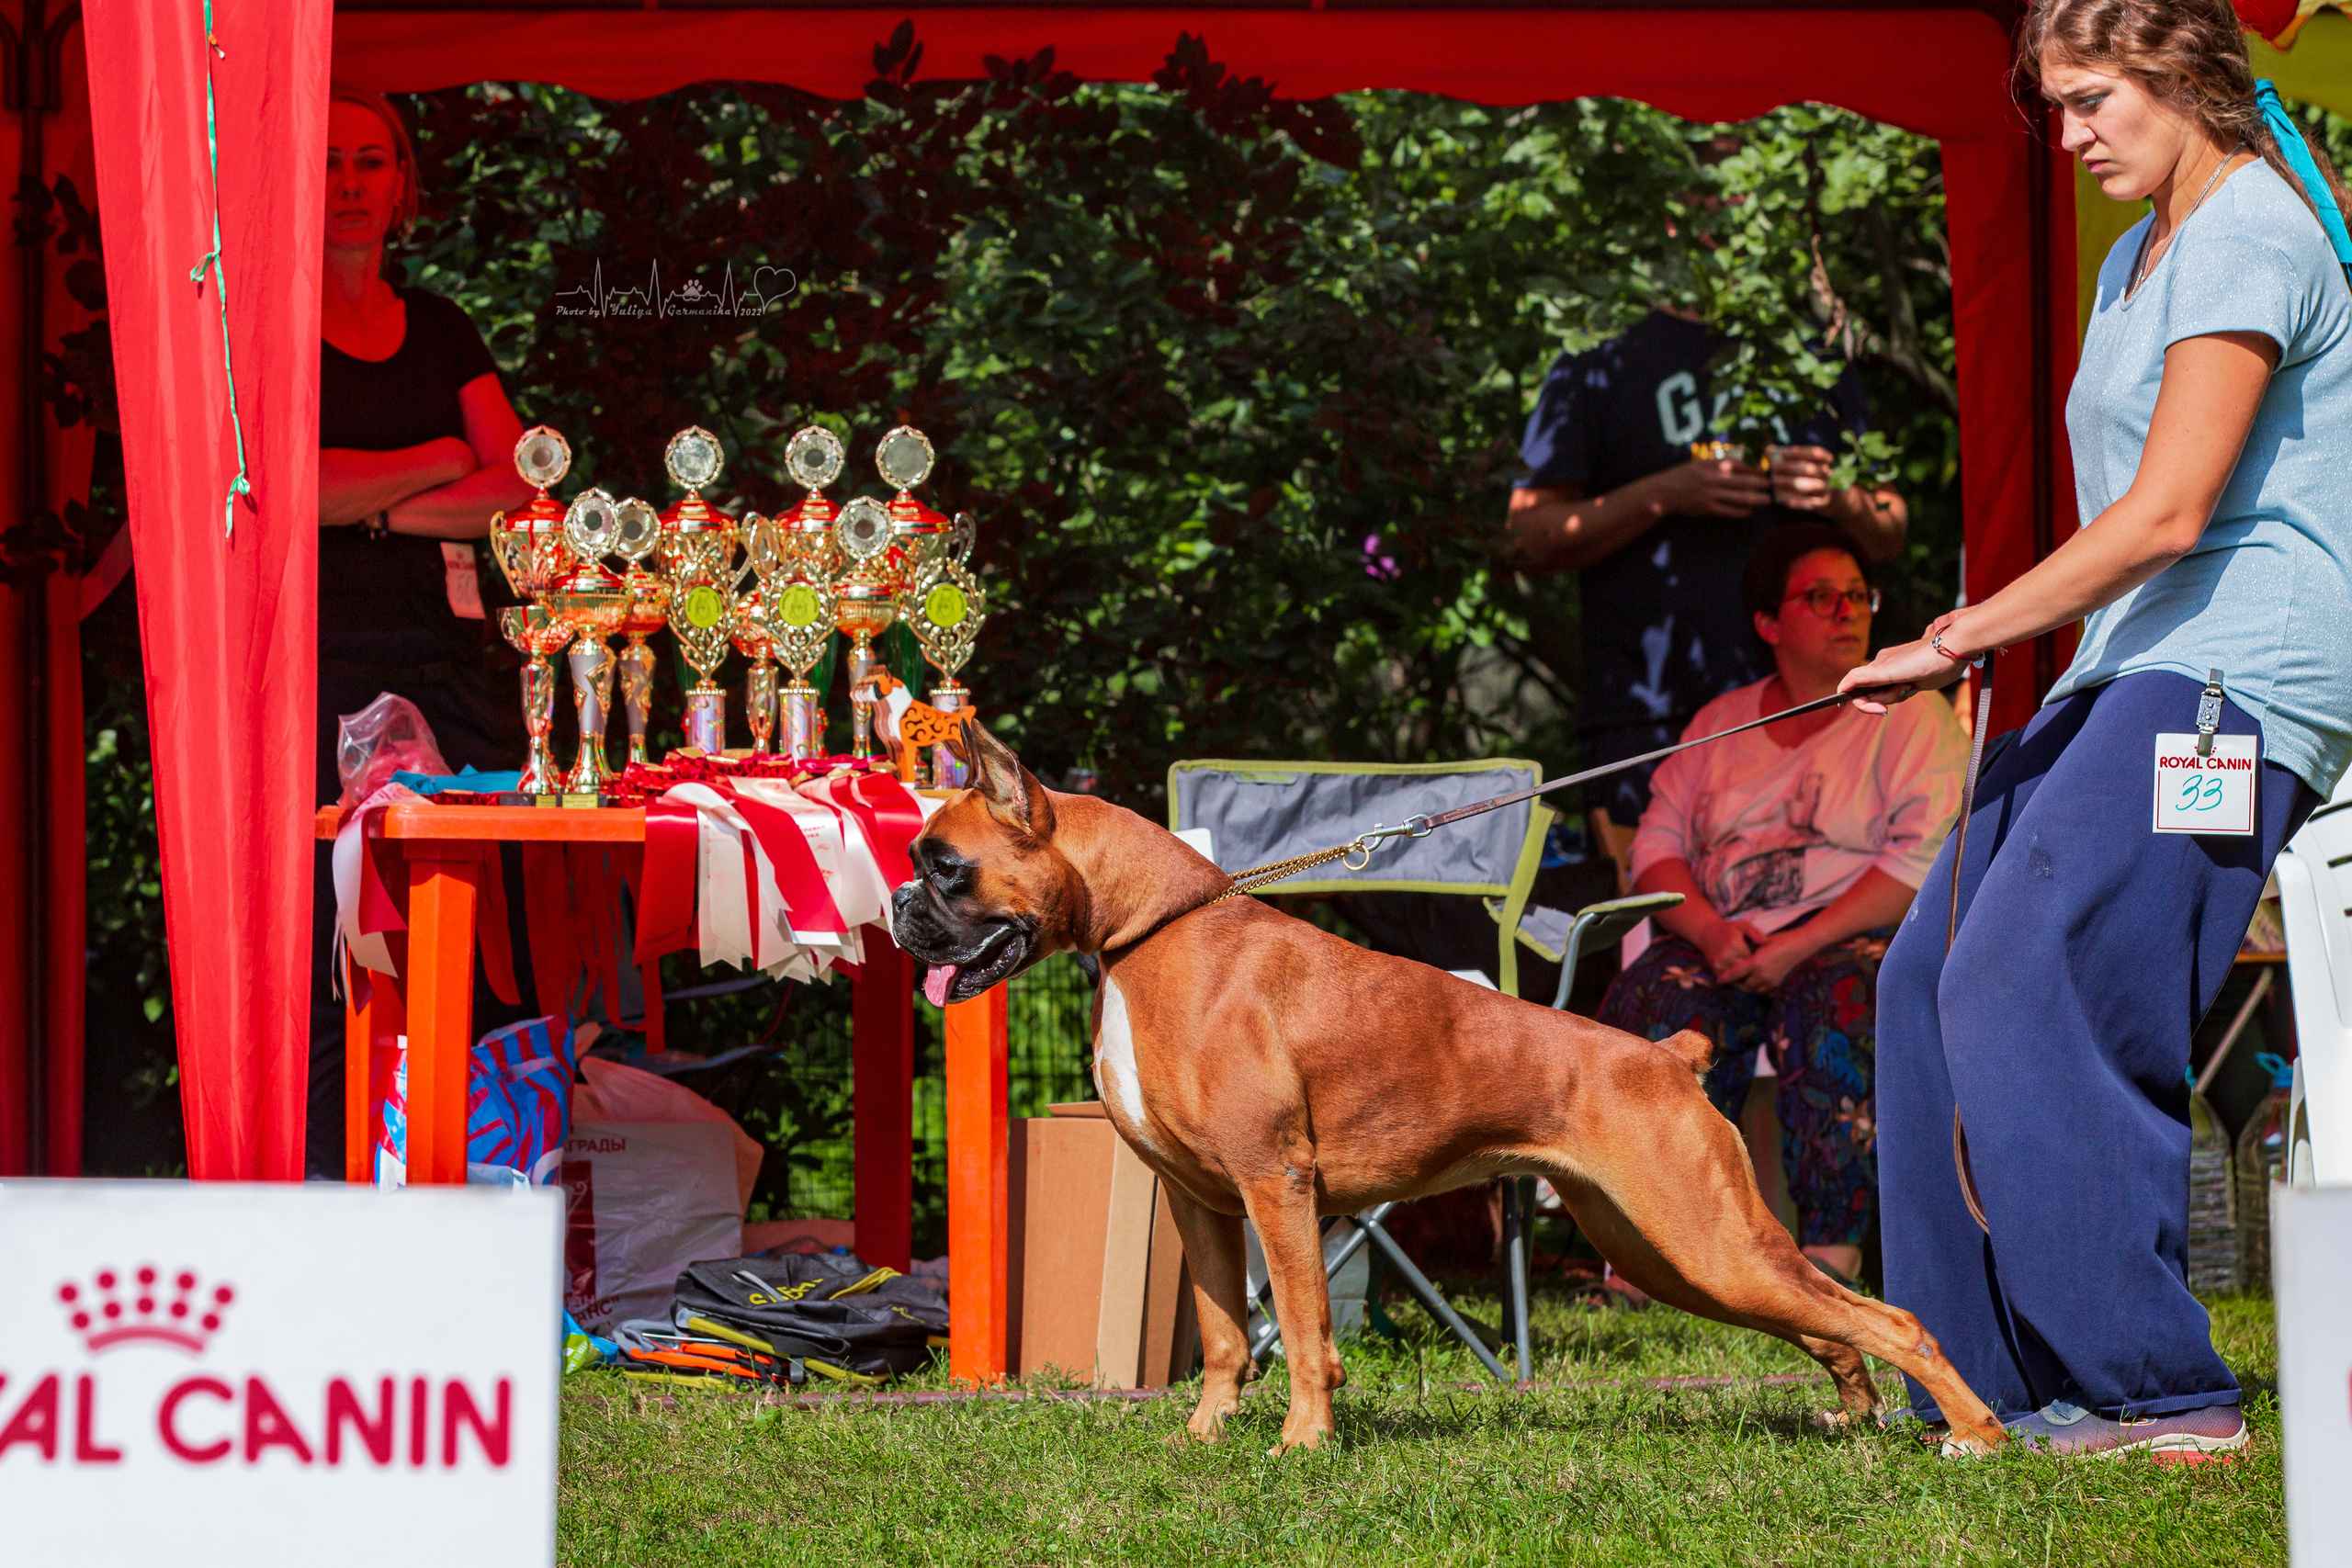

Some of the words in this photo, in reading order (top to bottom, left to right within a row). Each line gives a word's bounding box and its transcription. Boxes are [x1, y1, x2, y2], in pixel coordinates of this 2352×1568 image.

[2159, 756, 2203, 770] ROYAL
[2206, 757, 2252, 771] CANIN
[2175, 774, 2222, 811] 33
[0, 1372, 123, 1462] AL
[157, 1373, 512, 1468] CANIN
